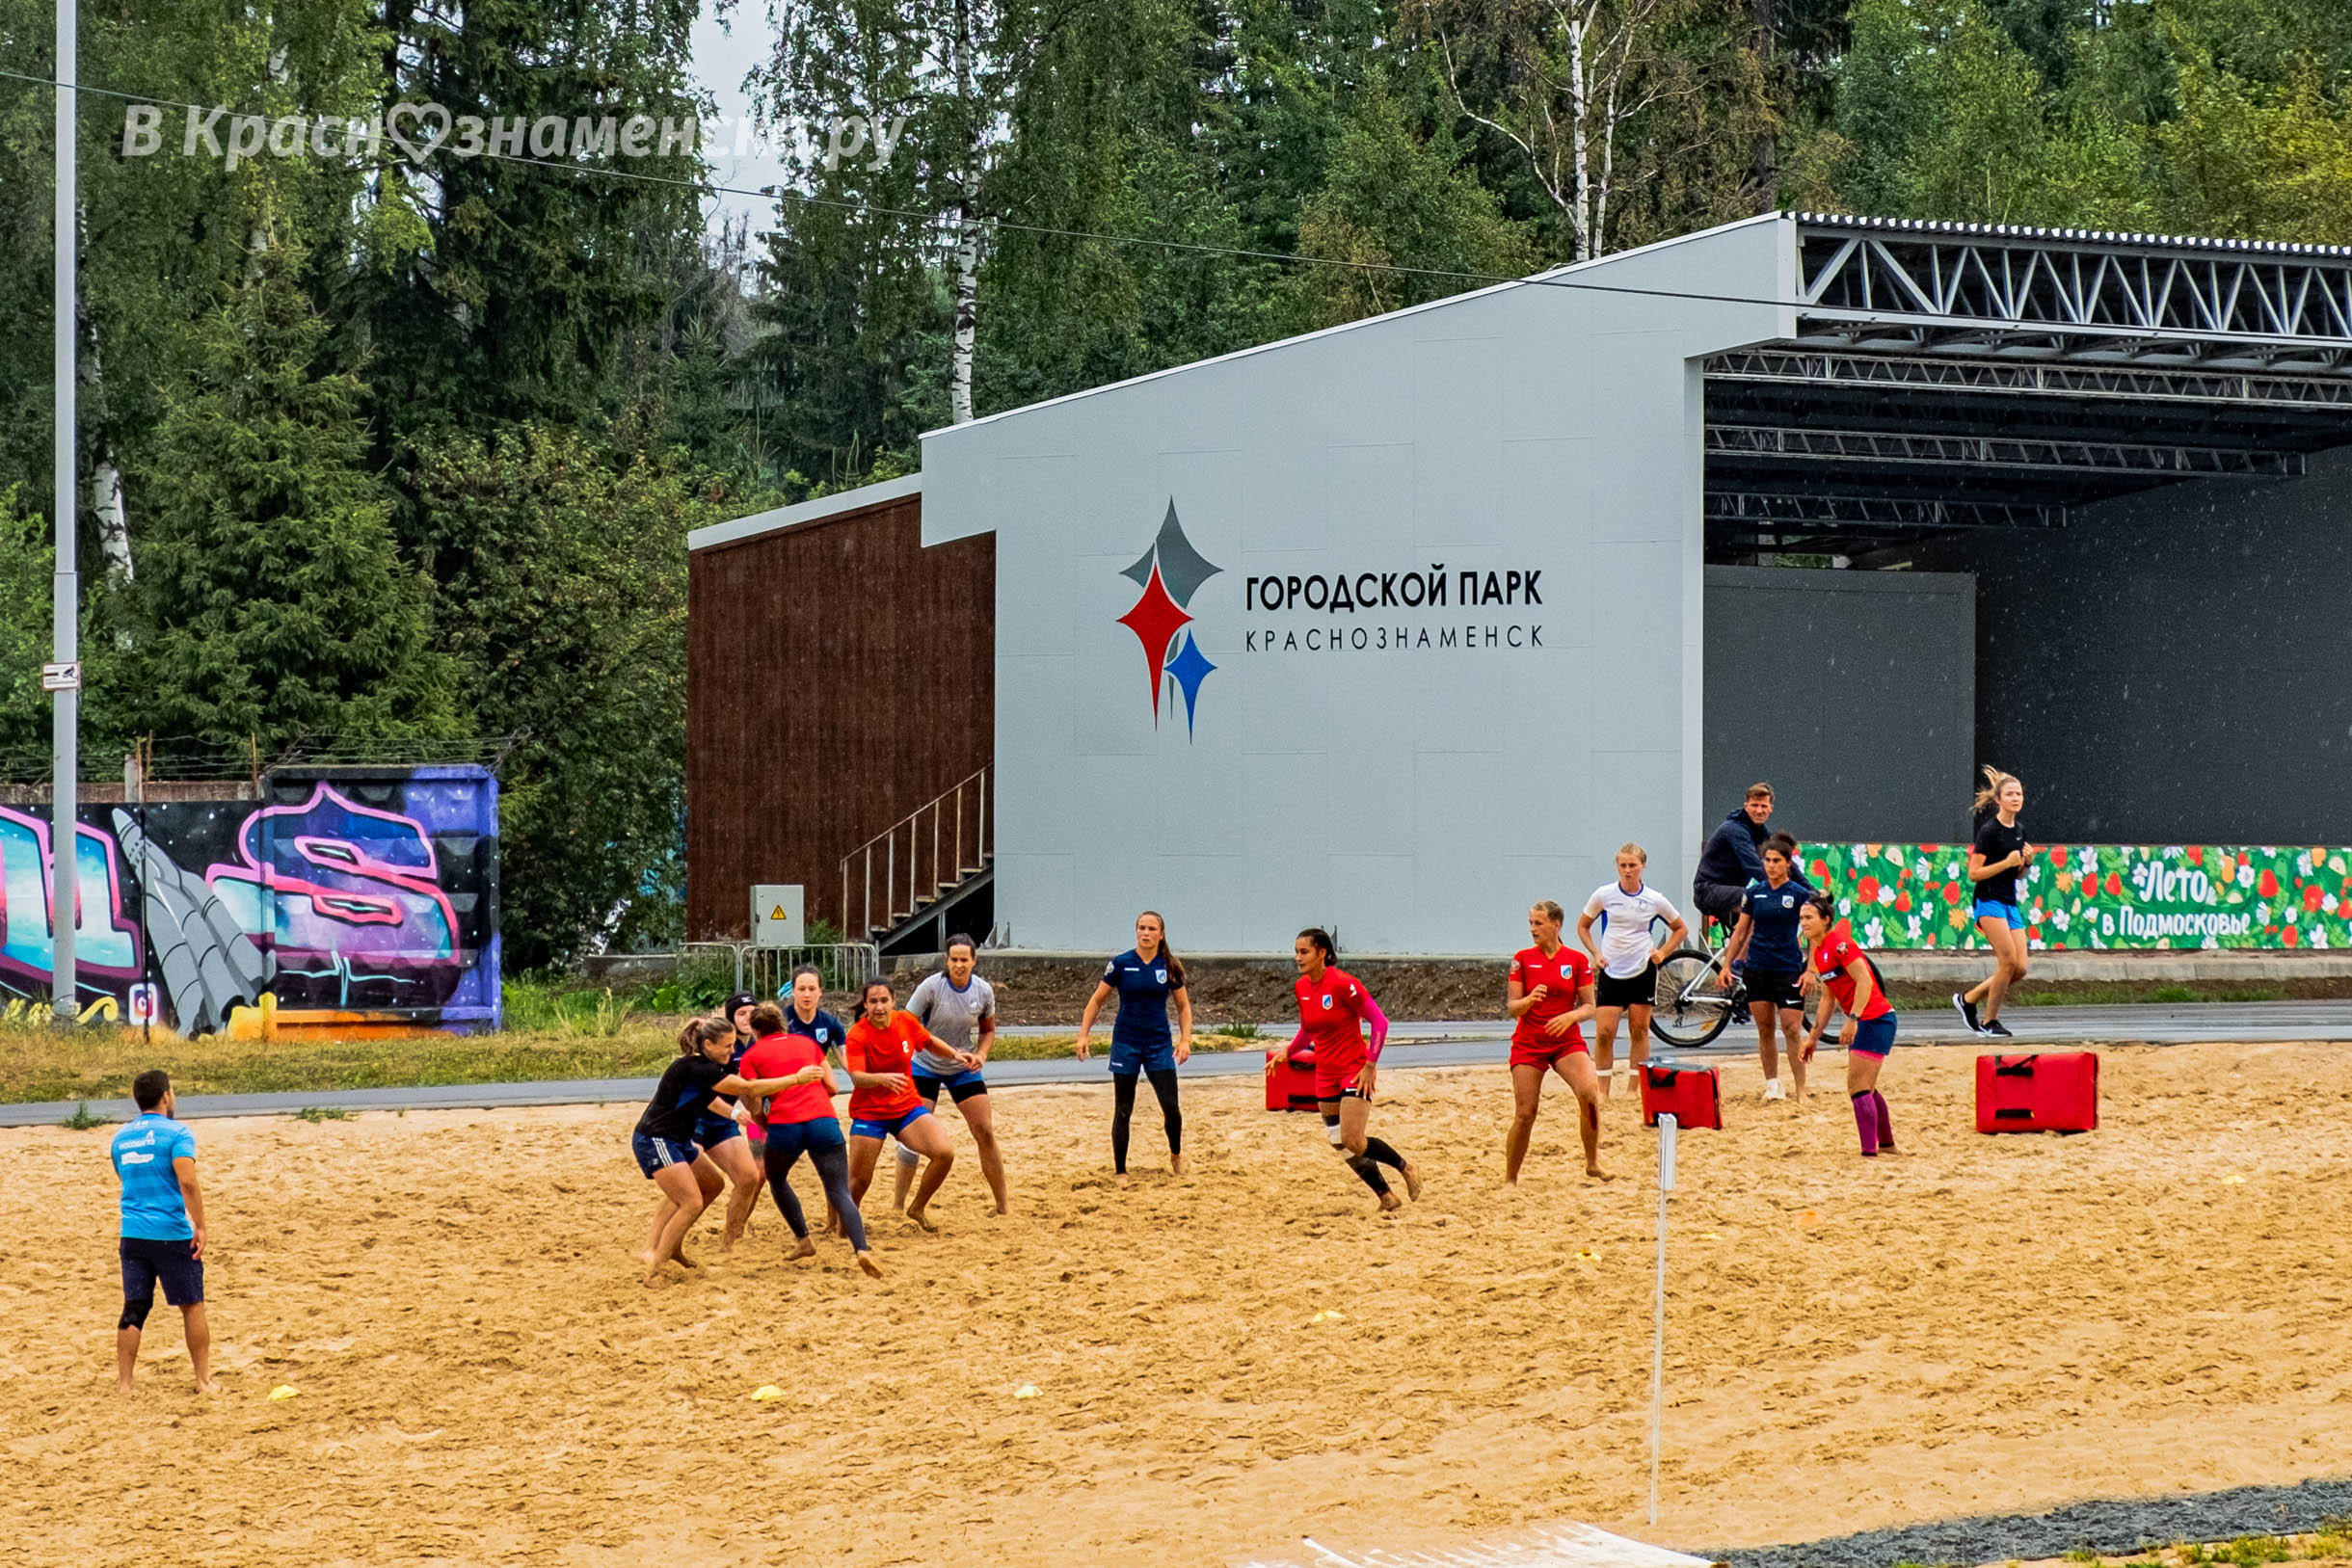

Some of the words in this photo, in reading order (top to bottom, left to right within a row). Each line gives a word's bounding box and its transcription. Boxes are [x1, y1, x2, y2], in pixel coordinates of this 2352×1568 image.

[1246, 563, 1447, 614] ГОРОДСКОЙ
[1458, 570, 1542, 605] ПАРК
[1246, 625, 1542, 652] КРАСНОЗНАМЕНСК
[2139, 861, 2208, 903] Лето
[2101, 913, 2116, 936] в
[2119, 905, 2251, 941] Подмосковье
